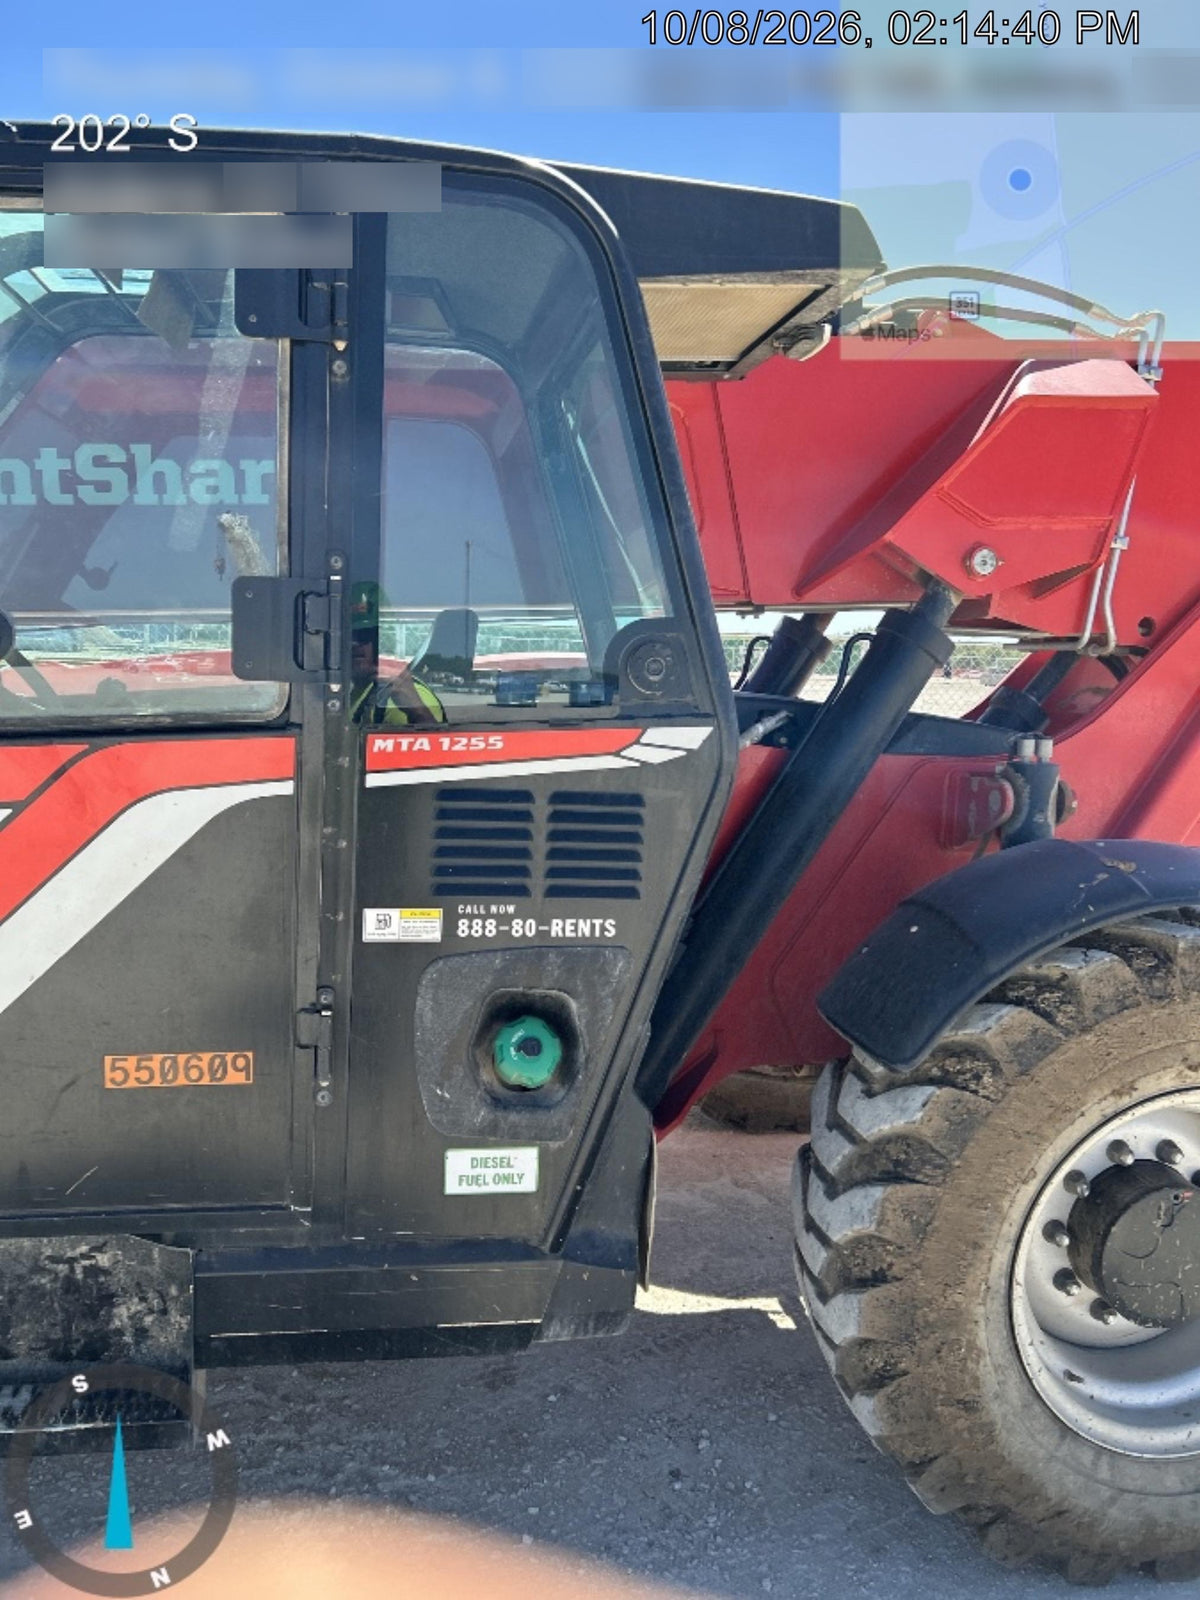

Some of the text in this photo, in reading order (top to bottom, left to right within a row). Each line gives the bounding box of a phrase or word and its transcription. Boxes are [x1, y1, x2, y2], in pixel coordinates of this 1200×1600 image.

[372, 735, 505, 753] MTA 1255
[457, 904, 517, 915] CALL NOW
[456, 918, 617, 938] 888-80-RENTS
[109, 1053, 251, 1087] 550609
[470, 1156, 515, 1170] DIESEL
[458, 1172, 525, 1188] FUEL ONLY
